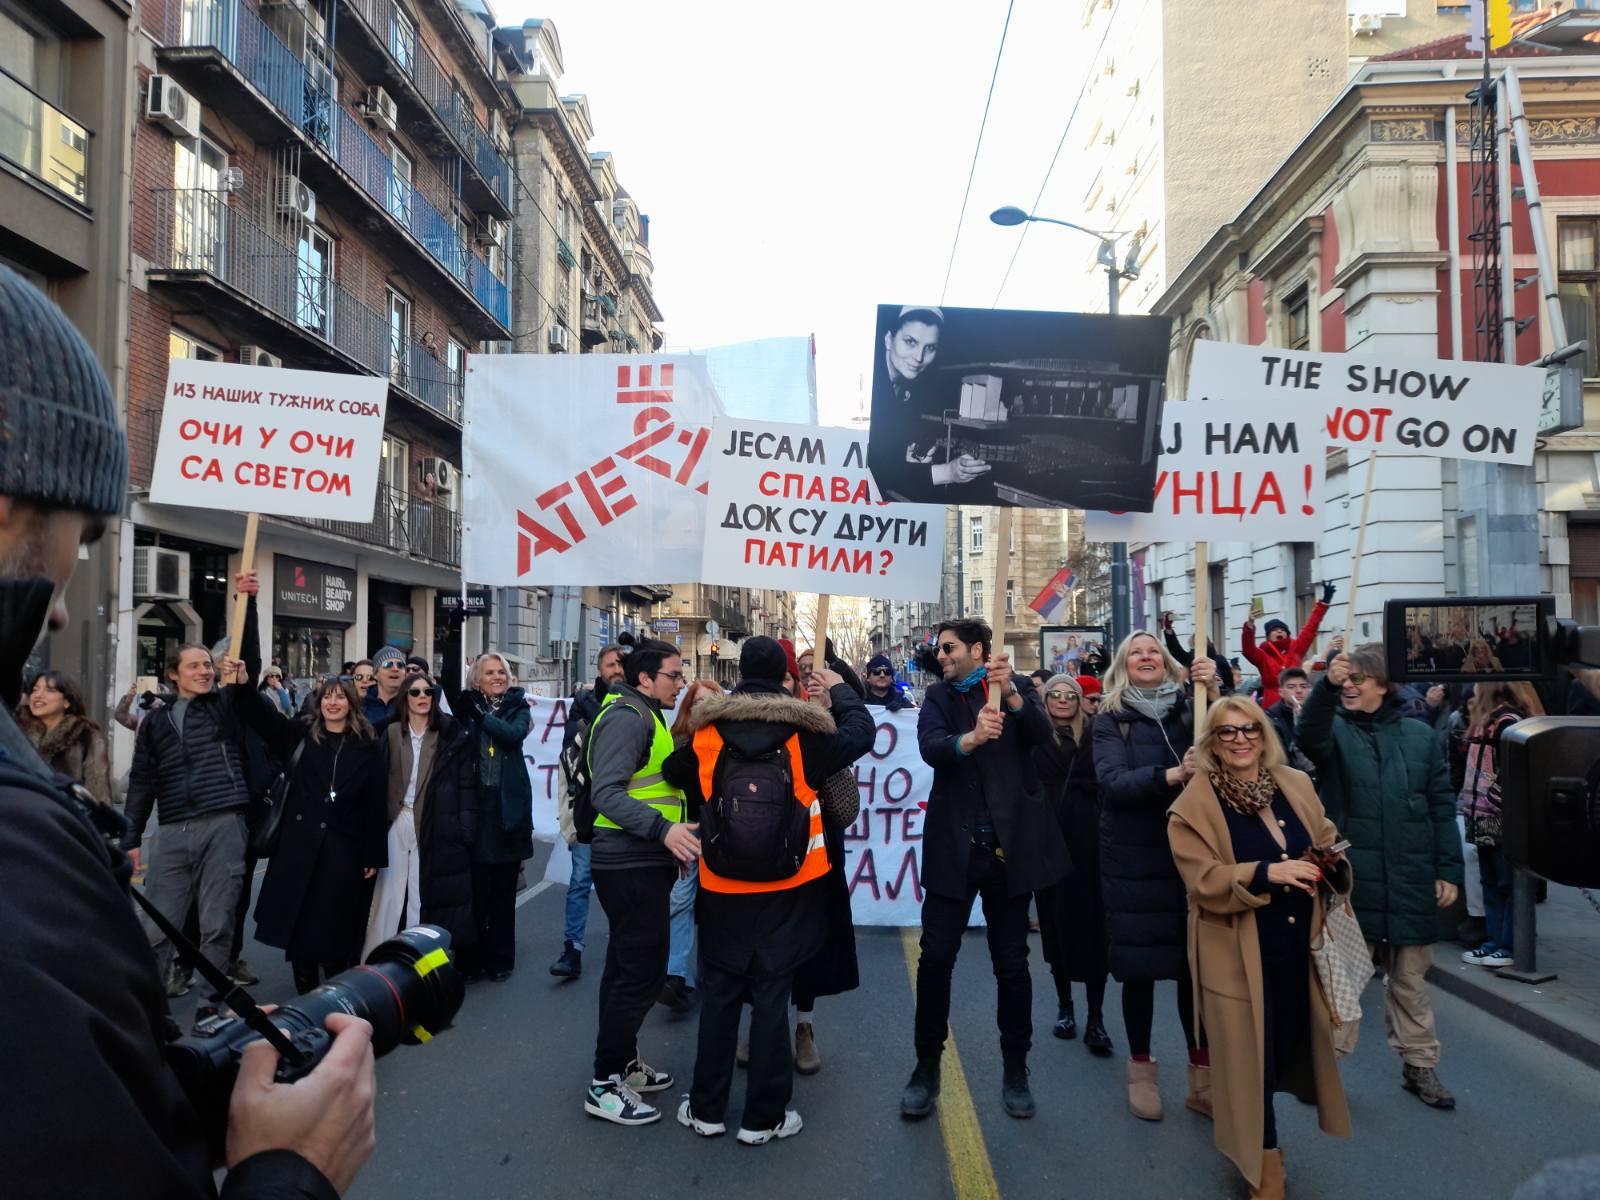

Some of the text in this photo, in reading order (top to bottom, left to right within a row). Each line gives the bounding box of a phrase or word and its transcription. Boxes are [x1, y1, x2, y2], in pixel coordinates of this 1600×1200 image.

[1262, 356, 1470, 401] THE SHOW
[173, 381, 381, 418] ИЗ НАШИХ ТУЖНИХ СОБА
[179, 418, 355, 459] ОЧИ У ОЧИ
[722, 430, 869, 469] ЈЕСАМ Л
[1205, 422, 1299, 456] НАМ
[1396, 416, 1450, 448] GO
[1462, 424, 1517, 454] ON
[180, 455, 352, 496] СА СВЕТОМ
[758, 471, 890, 506] СПАВА
[720, 504, 928, 548] ДОК СУ ДРУГИ
[744, 538, 895, 577] ПАТИЛИ?
[281, 591, 318, 604] UNITECH
[325, 575, 343, 588] HAIR
[325, 587, 352, 602] BEAUTY
[325, 600, 345, 612] SHOP
